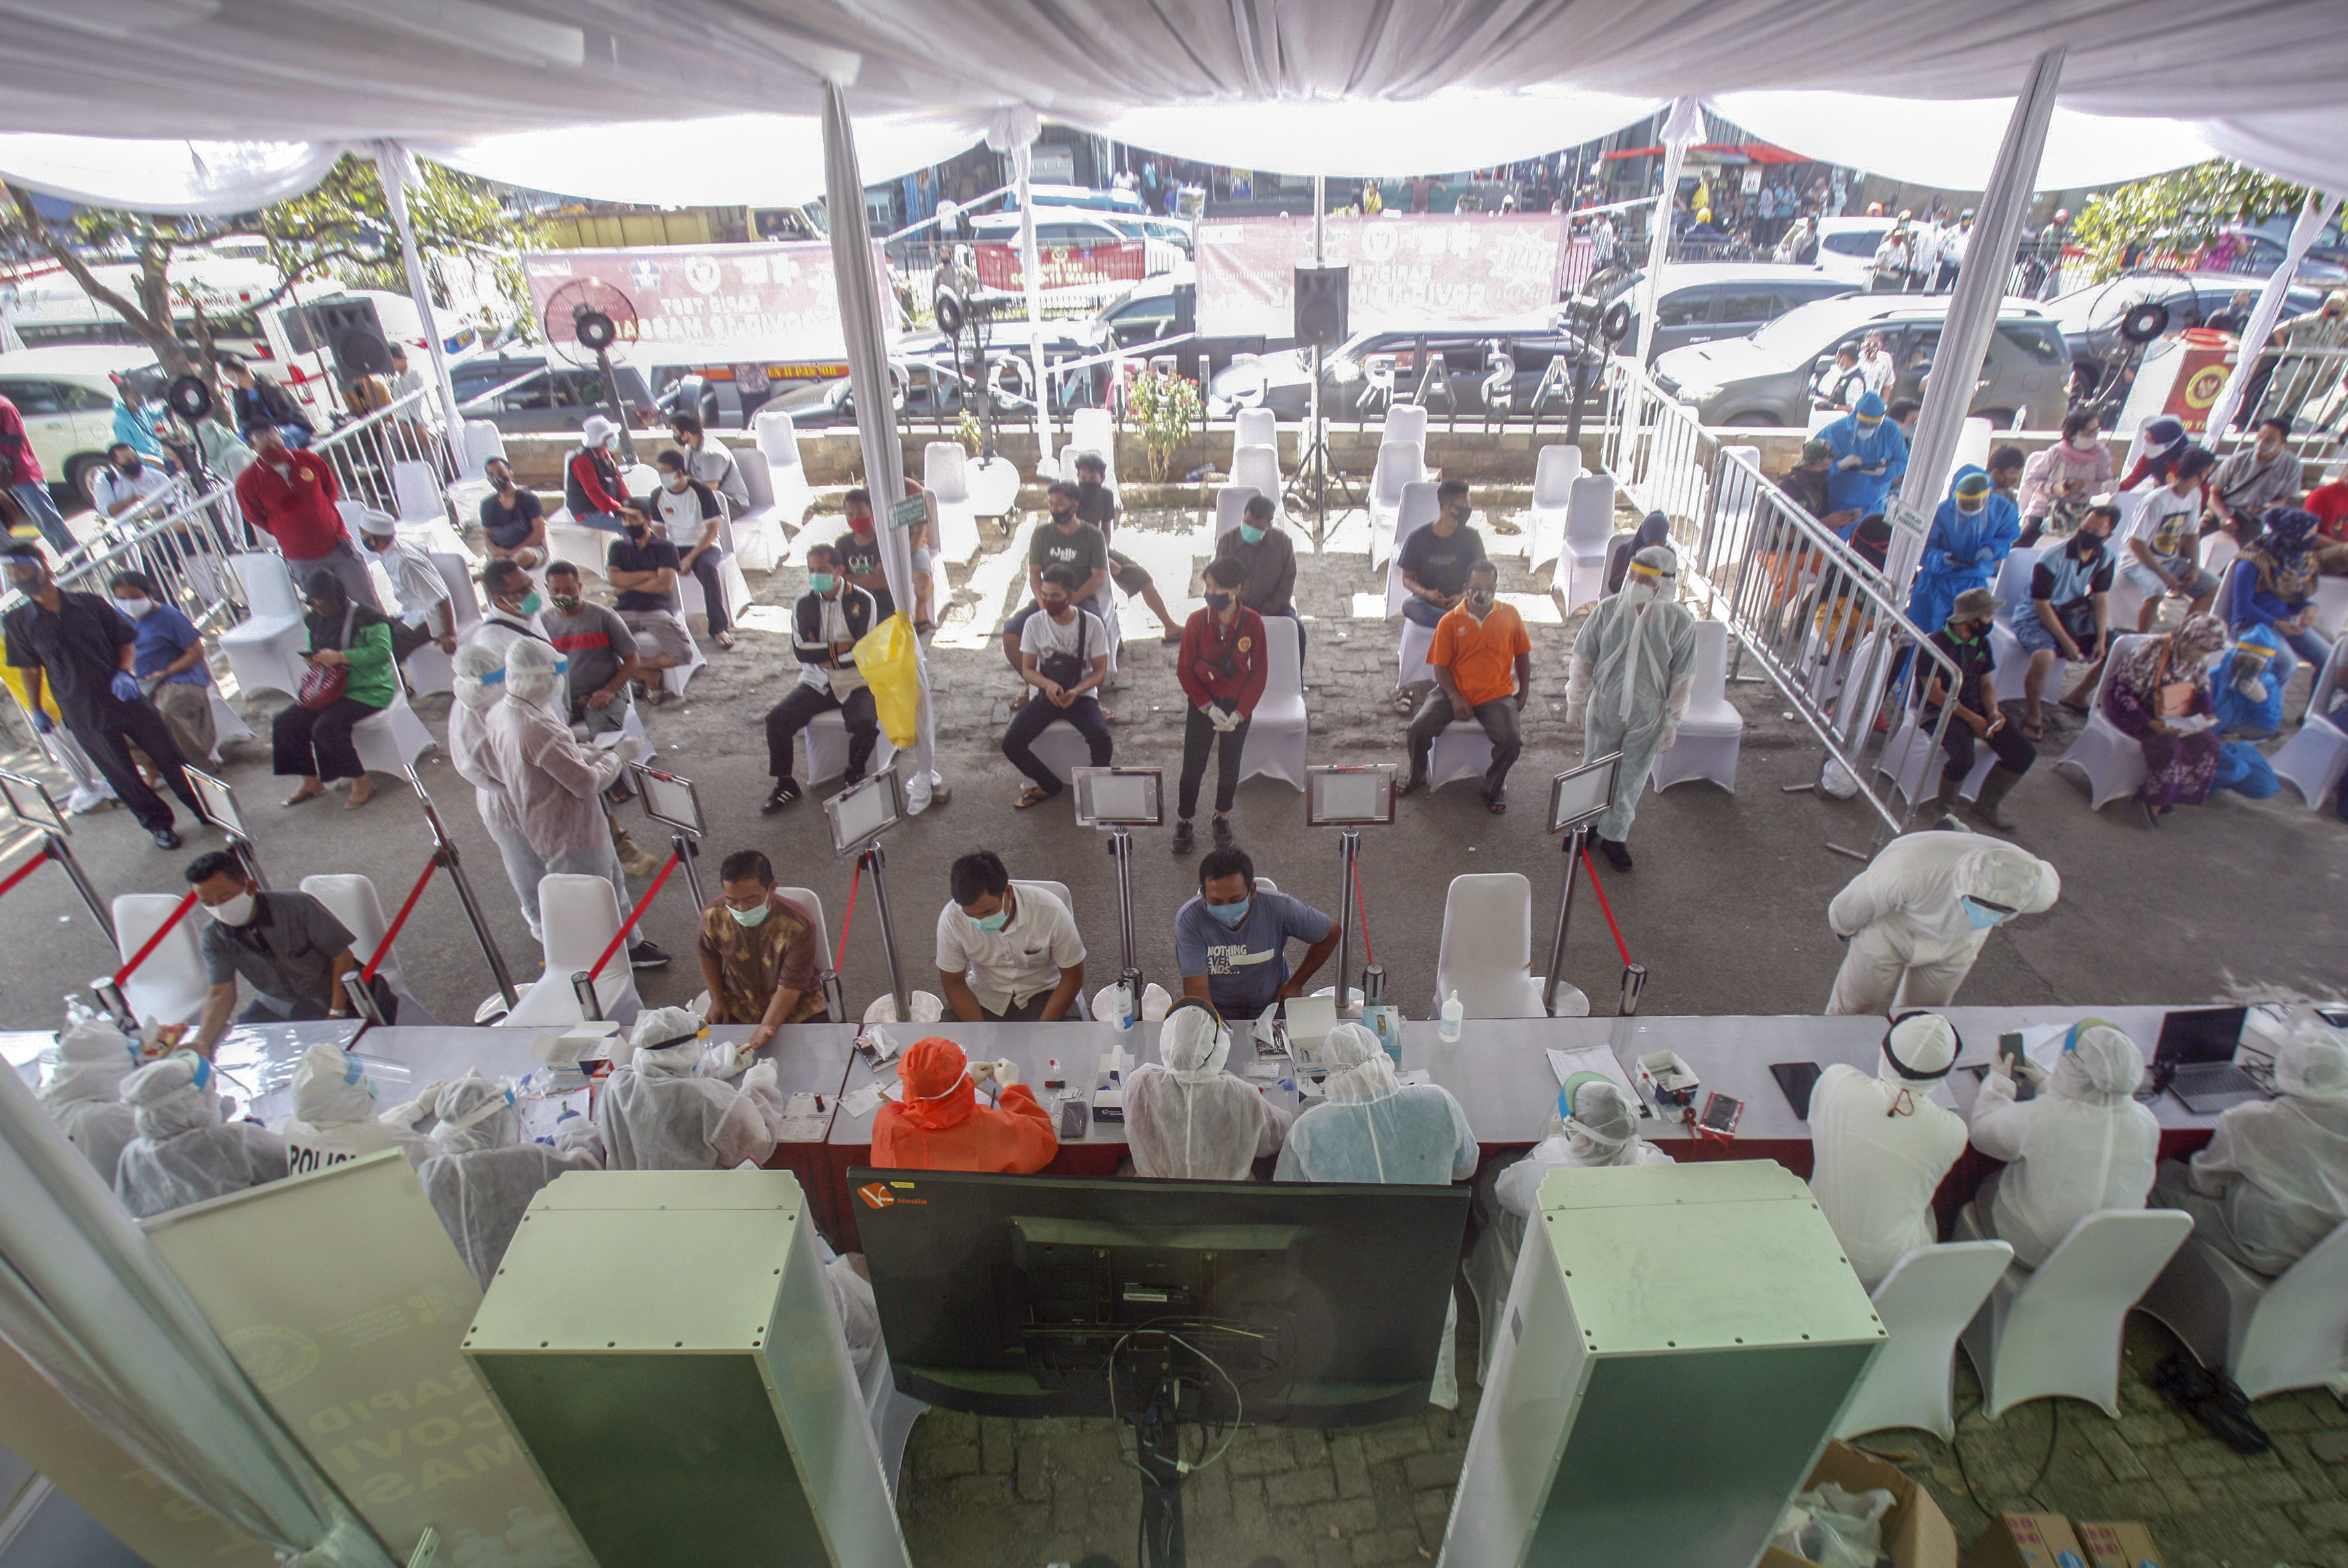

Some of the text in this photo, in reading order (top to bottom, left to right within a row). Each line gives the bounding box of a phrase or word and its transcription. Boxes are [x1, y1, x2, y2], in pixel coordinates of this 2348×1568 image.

[1050, 547, 1077, 560] #Jelly
[1207, 944, 1247, 957] NOTHING
[289, 1144, 356, 1176] POL
